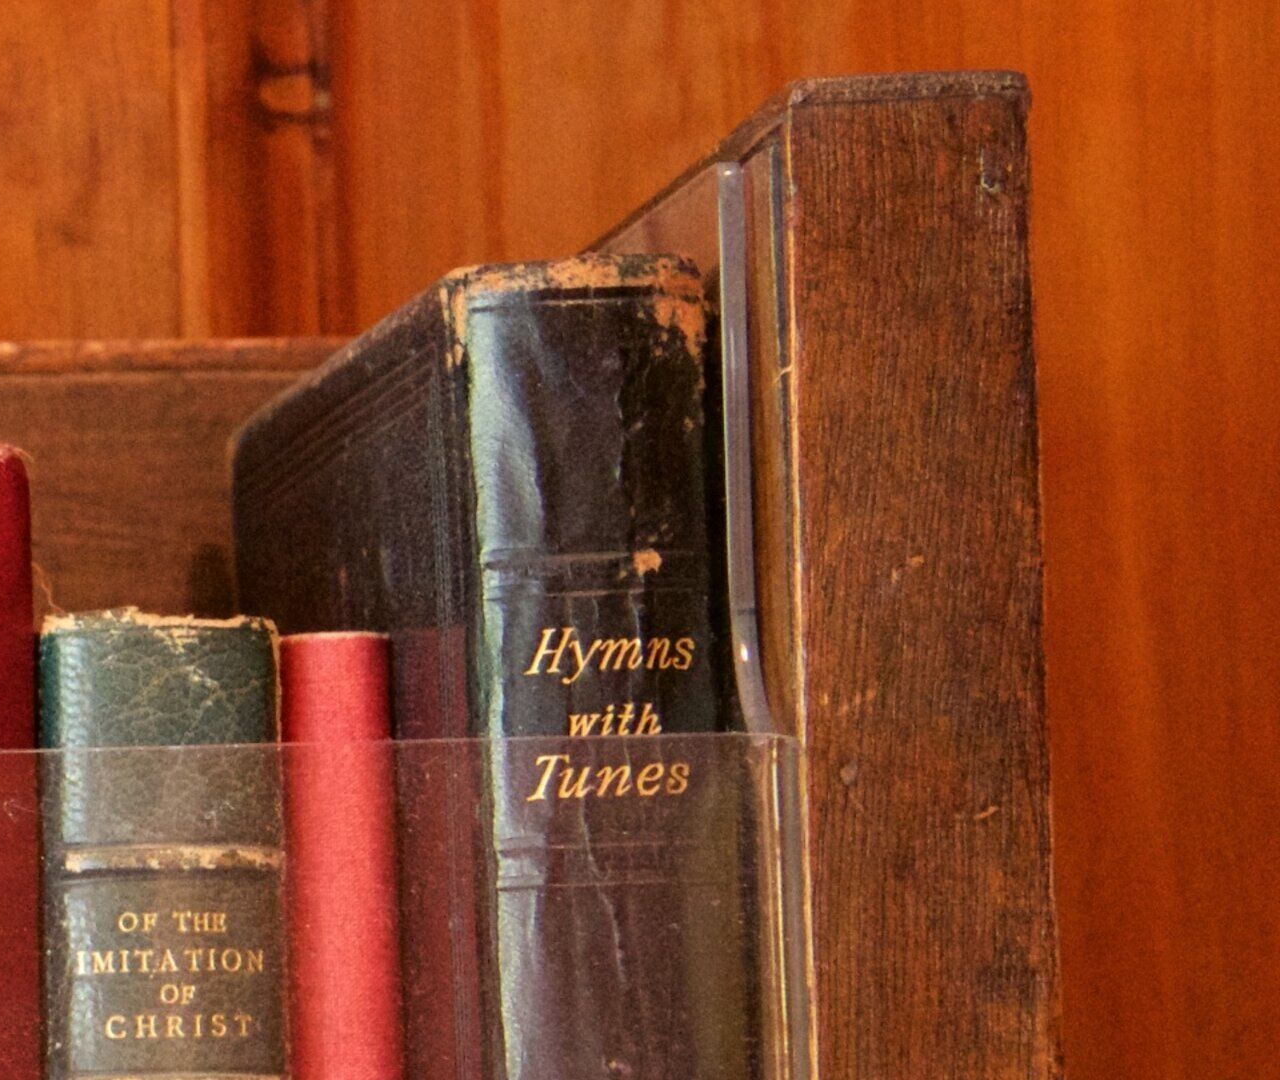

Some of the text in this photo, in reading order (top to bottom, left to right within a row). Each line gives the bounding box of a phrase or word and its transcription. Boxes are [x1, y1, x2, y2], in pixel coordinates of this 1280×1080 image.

[523, 626, 695, 685] Hymns
[568, 702, 662, 738] with
[526, 754, 691, 802] Tunes
[117, 909, 228, 934] OF THE
[76, 948, 265, 977] IMITATION
[159, 983, 197, 1005] OF
[104, 1013, 253, 1040] CHRIST
